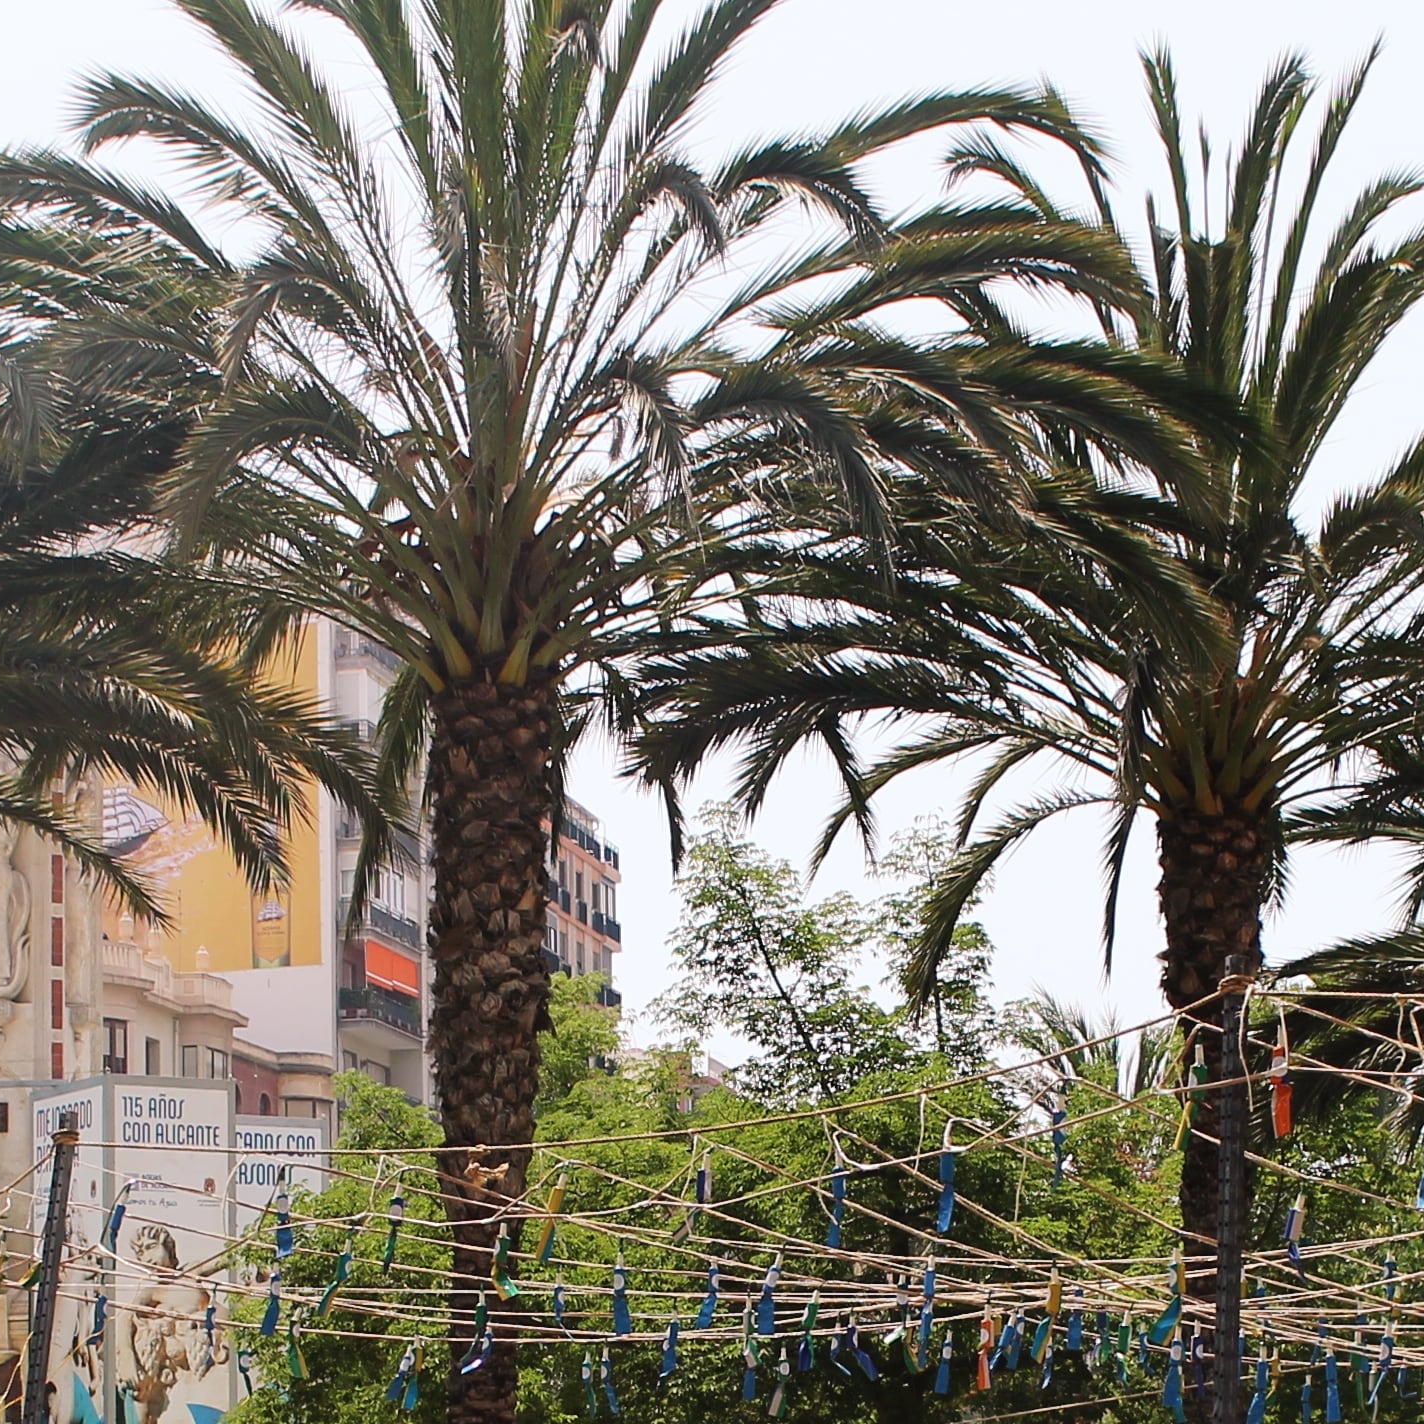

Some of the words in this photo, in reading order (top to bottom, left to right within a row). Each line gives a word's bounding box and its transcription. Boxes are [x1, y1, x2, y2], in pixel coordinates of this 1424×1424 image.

[122, 1096, 143, 1118] 115
[148, 1093, 185, 1120] AÑOS
[122, 1121, 152, 1143] CON
[155, 1122, 220, 1147] ALICANTE
[286, 1133, 316, 1158] CON
